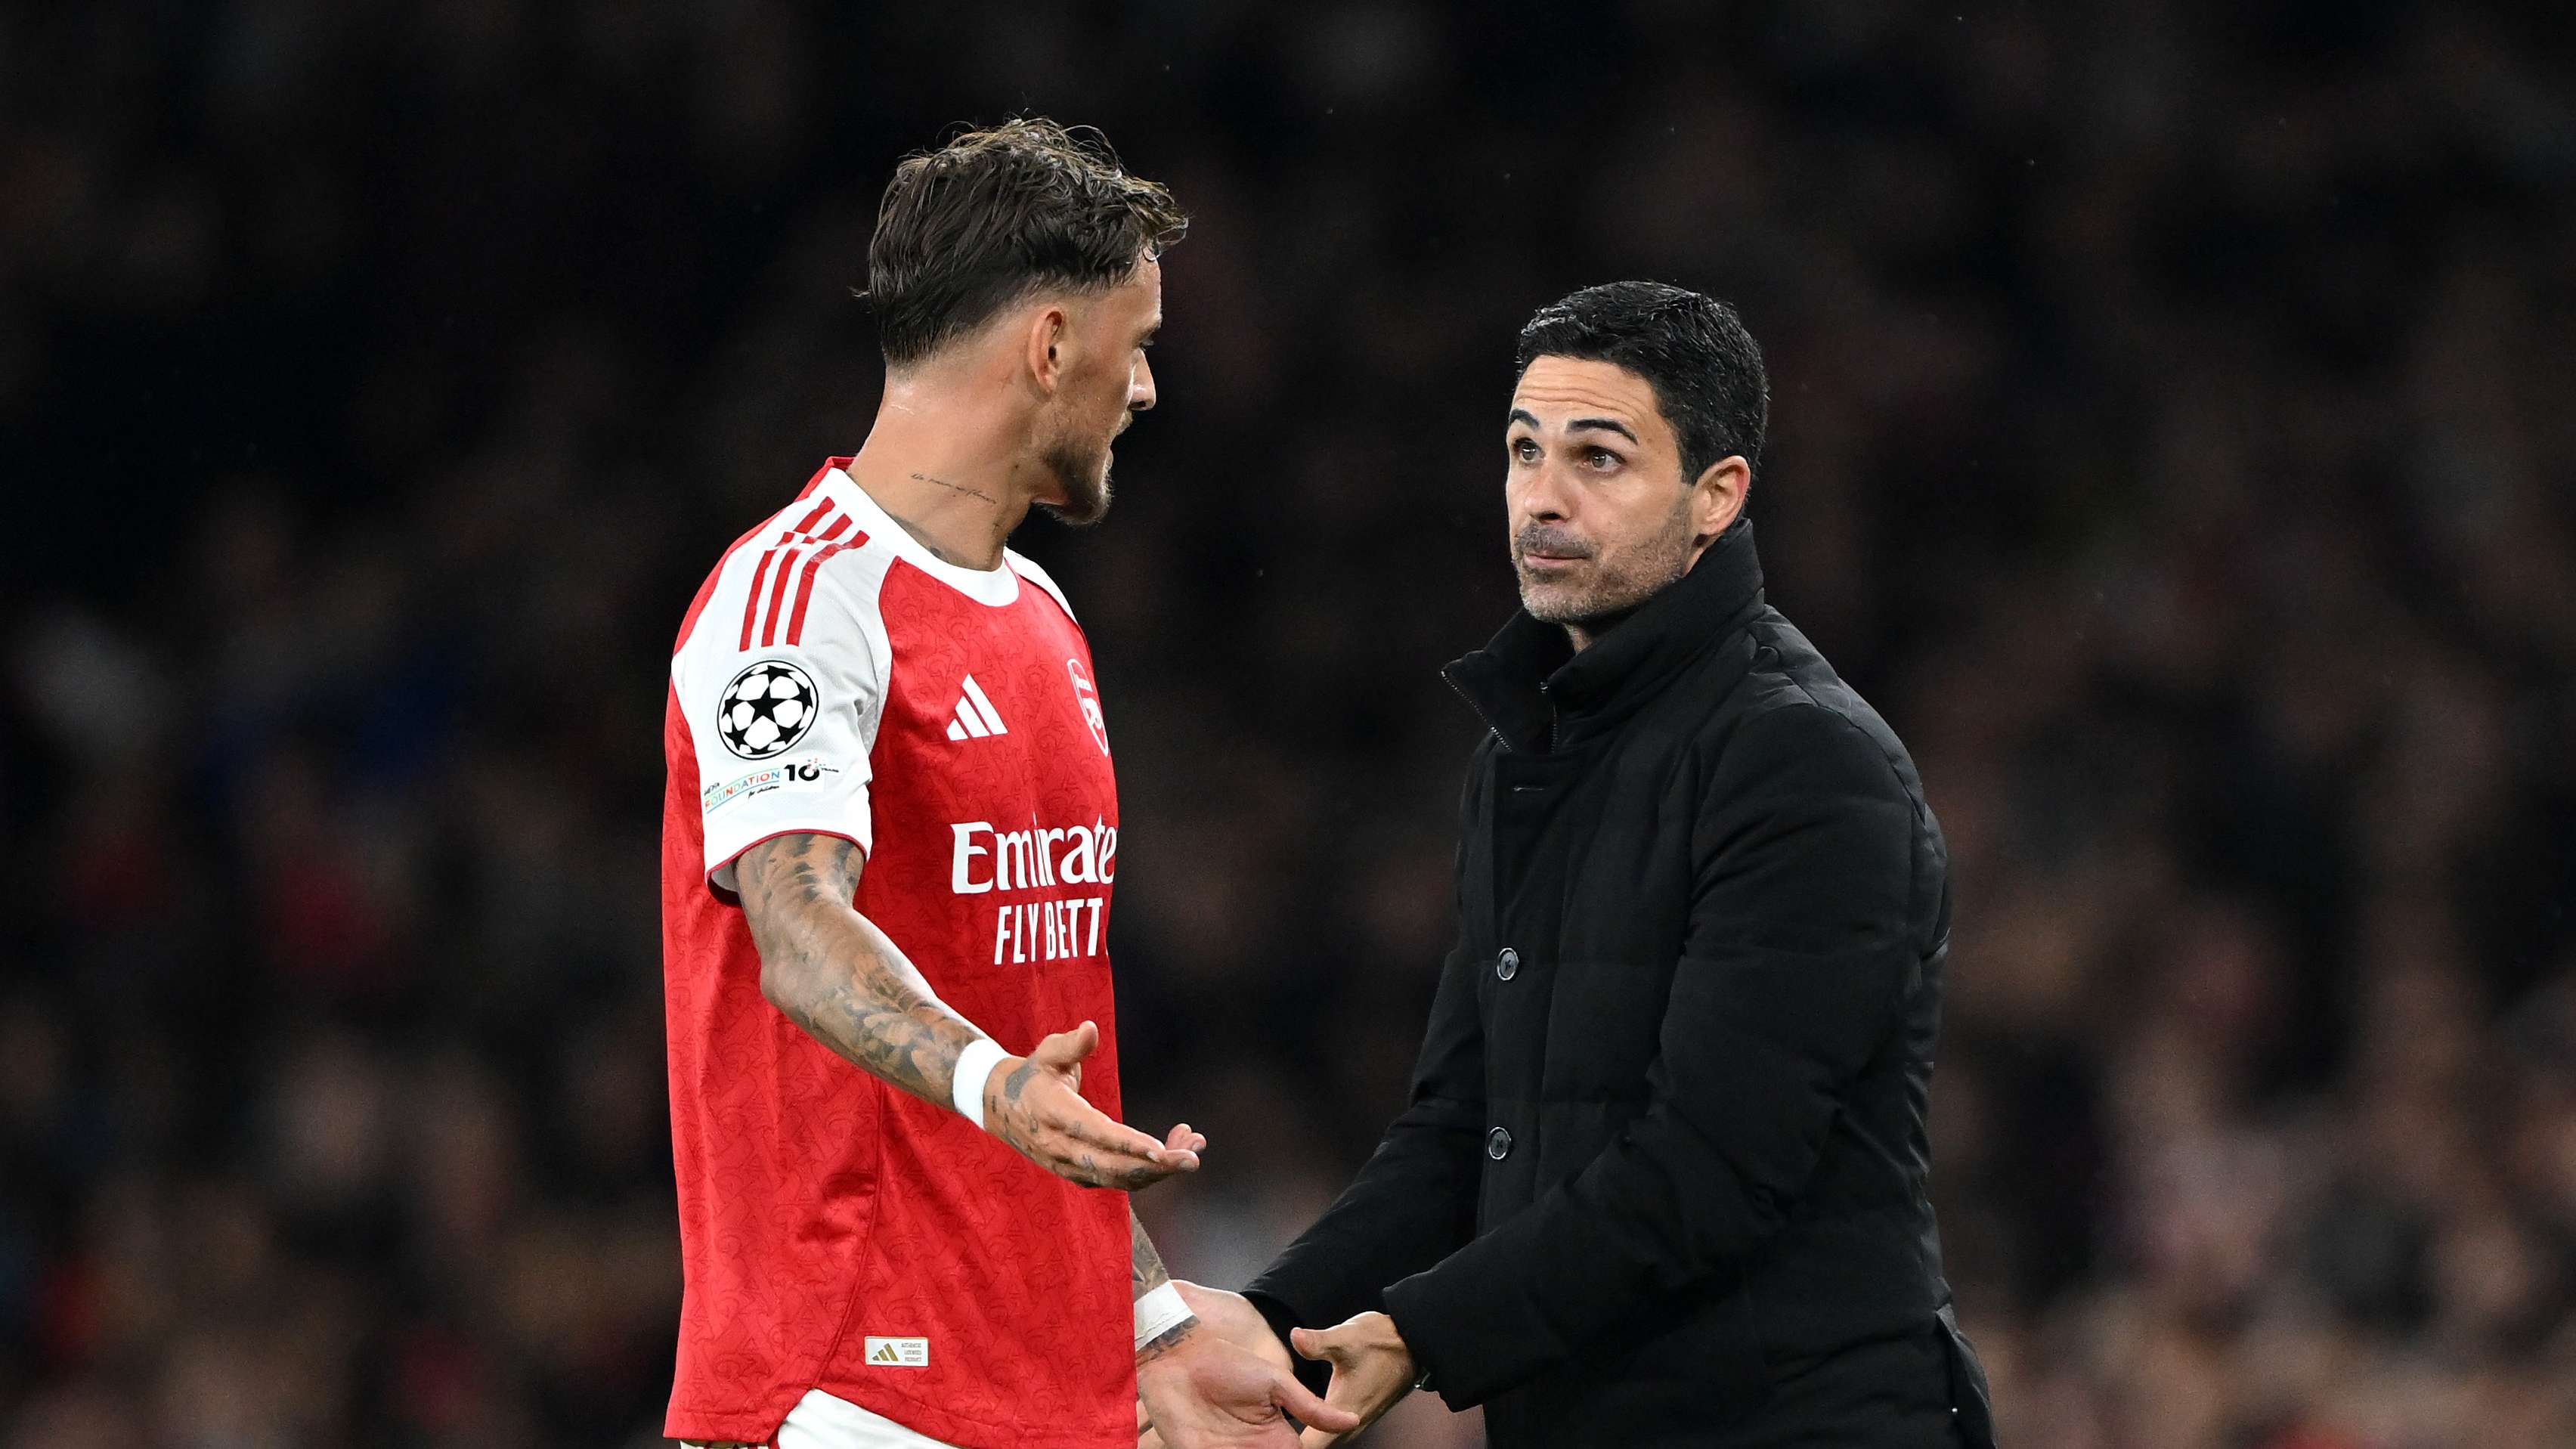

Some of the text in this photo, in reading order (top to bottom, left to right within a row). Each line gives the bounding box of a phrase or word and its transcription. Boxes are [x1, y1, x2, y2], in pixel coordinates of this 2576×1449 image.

[705, 770, 780, 810] FOUNDATION
[784, 763, 820, 782] 10
[994, 897, 1108, 965] FLY BETT
